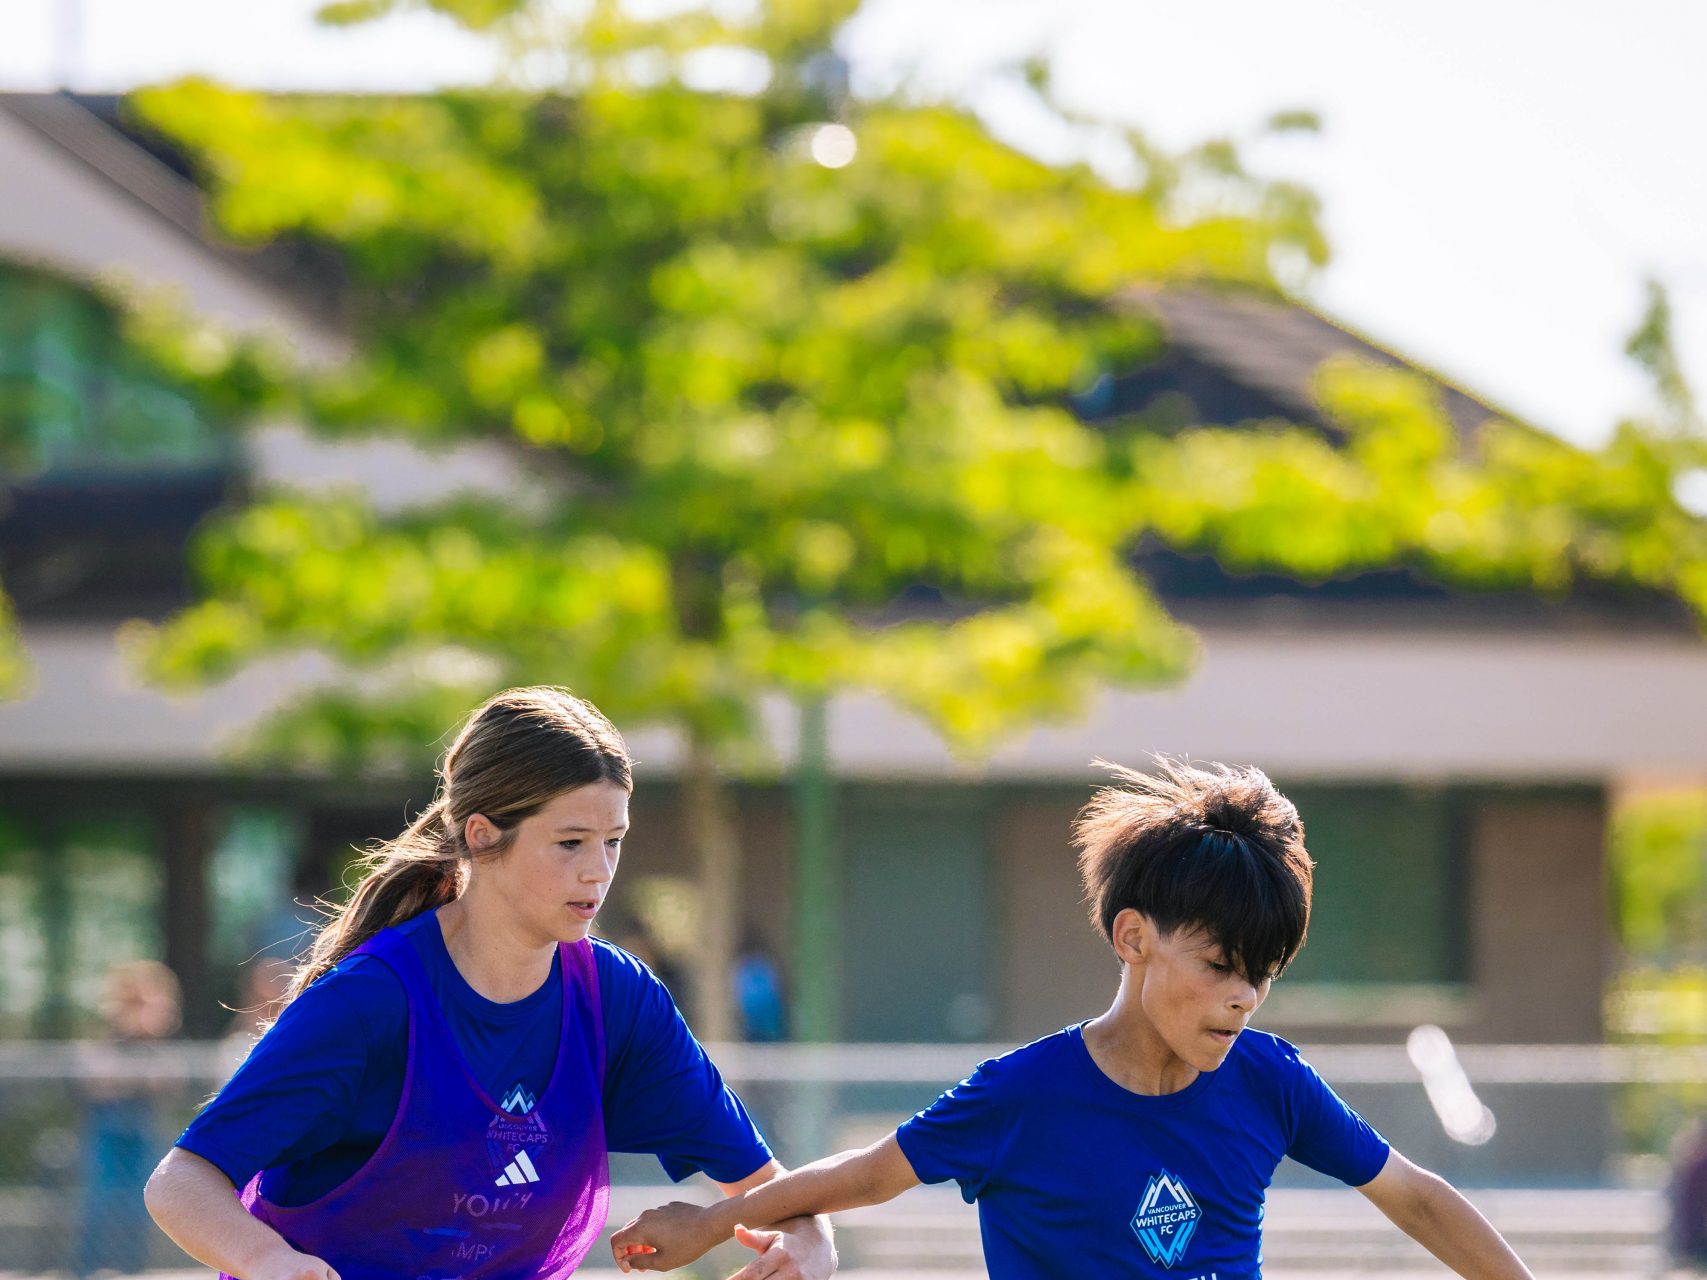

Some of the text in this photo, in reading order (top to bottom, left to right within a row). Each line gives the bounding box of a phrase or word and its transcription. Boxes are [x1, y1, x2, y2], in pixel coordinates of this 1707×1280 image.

[1147, 1203, 1187, 1215] VANCOUVER
[1135, 1209, 1197, 1228] WHITECAPS
[1160, 1224, 1174, 1236] FC
